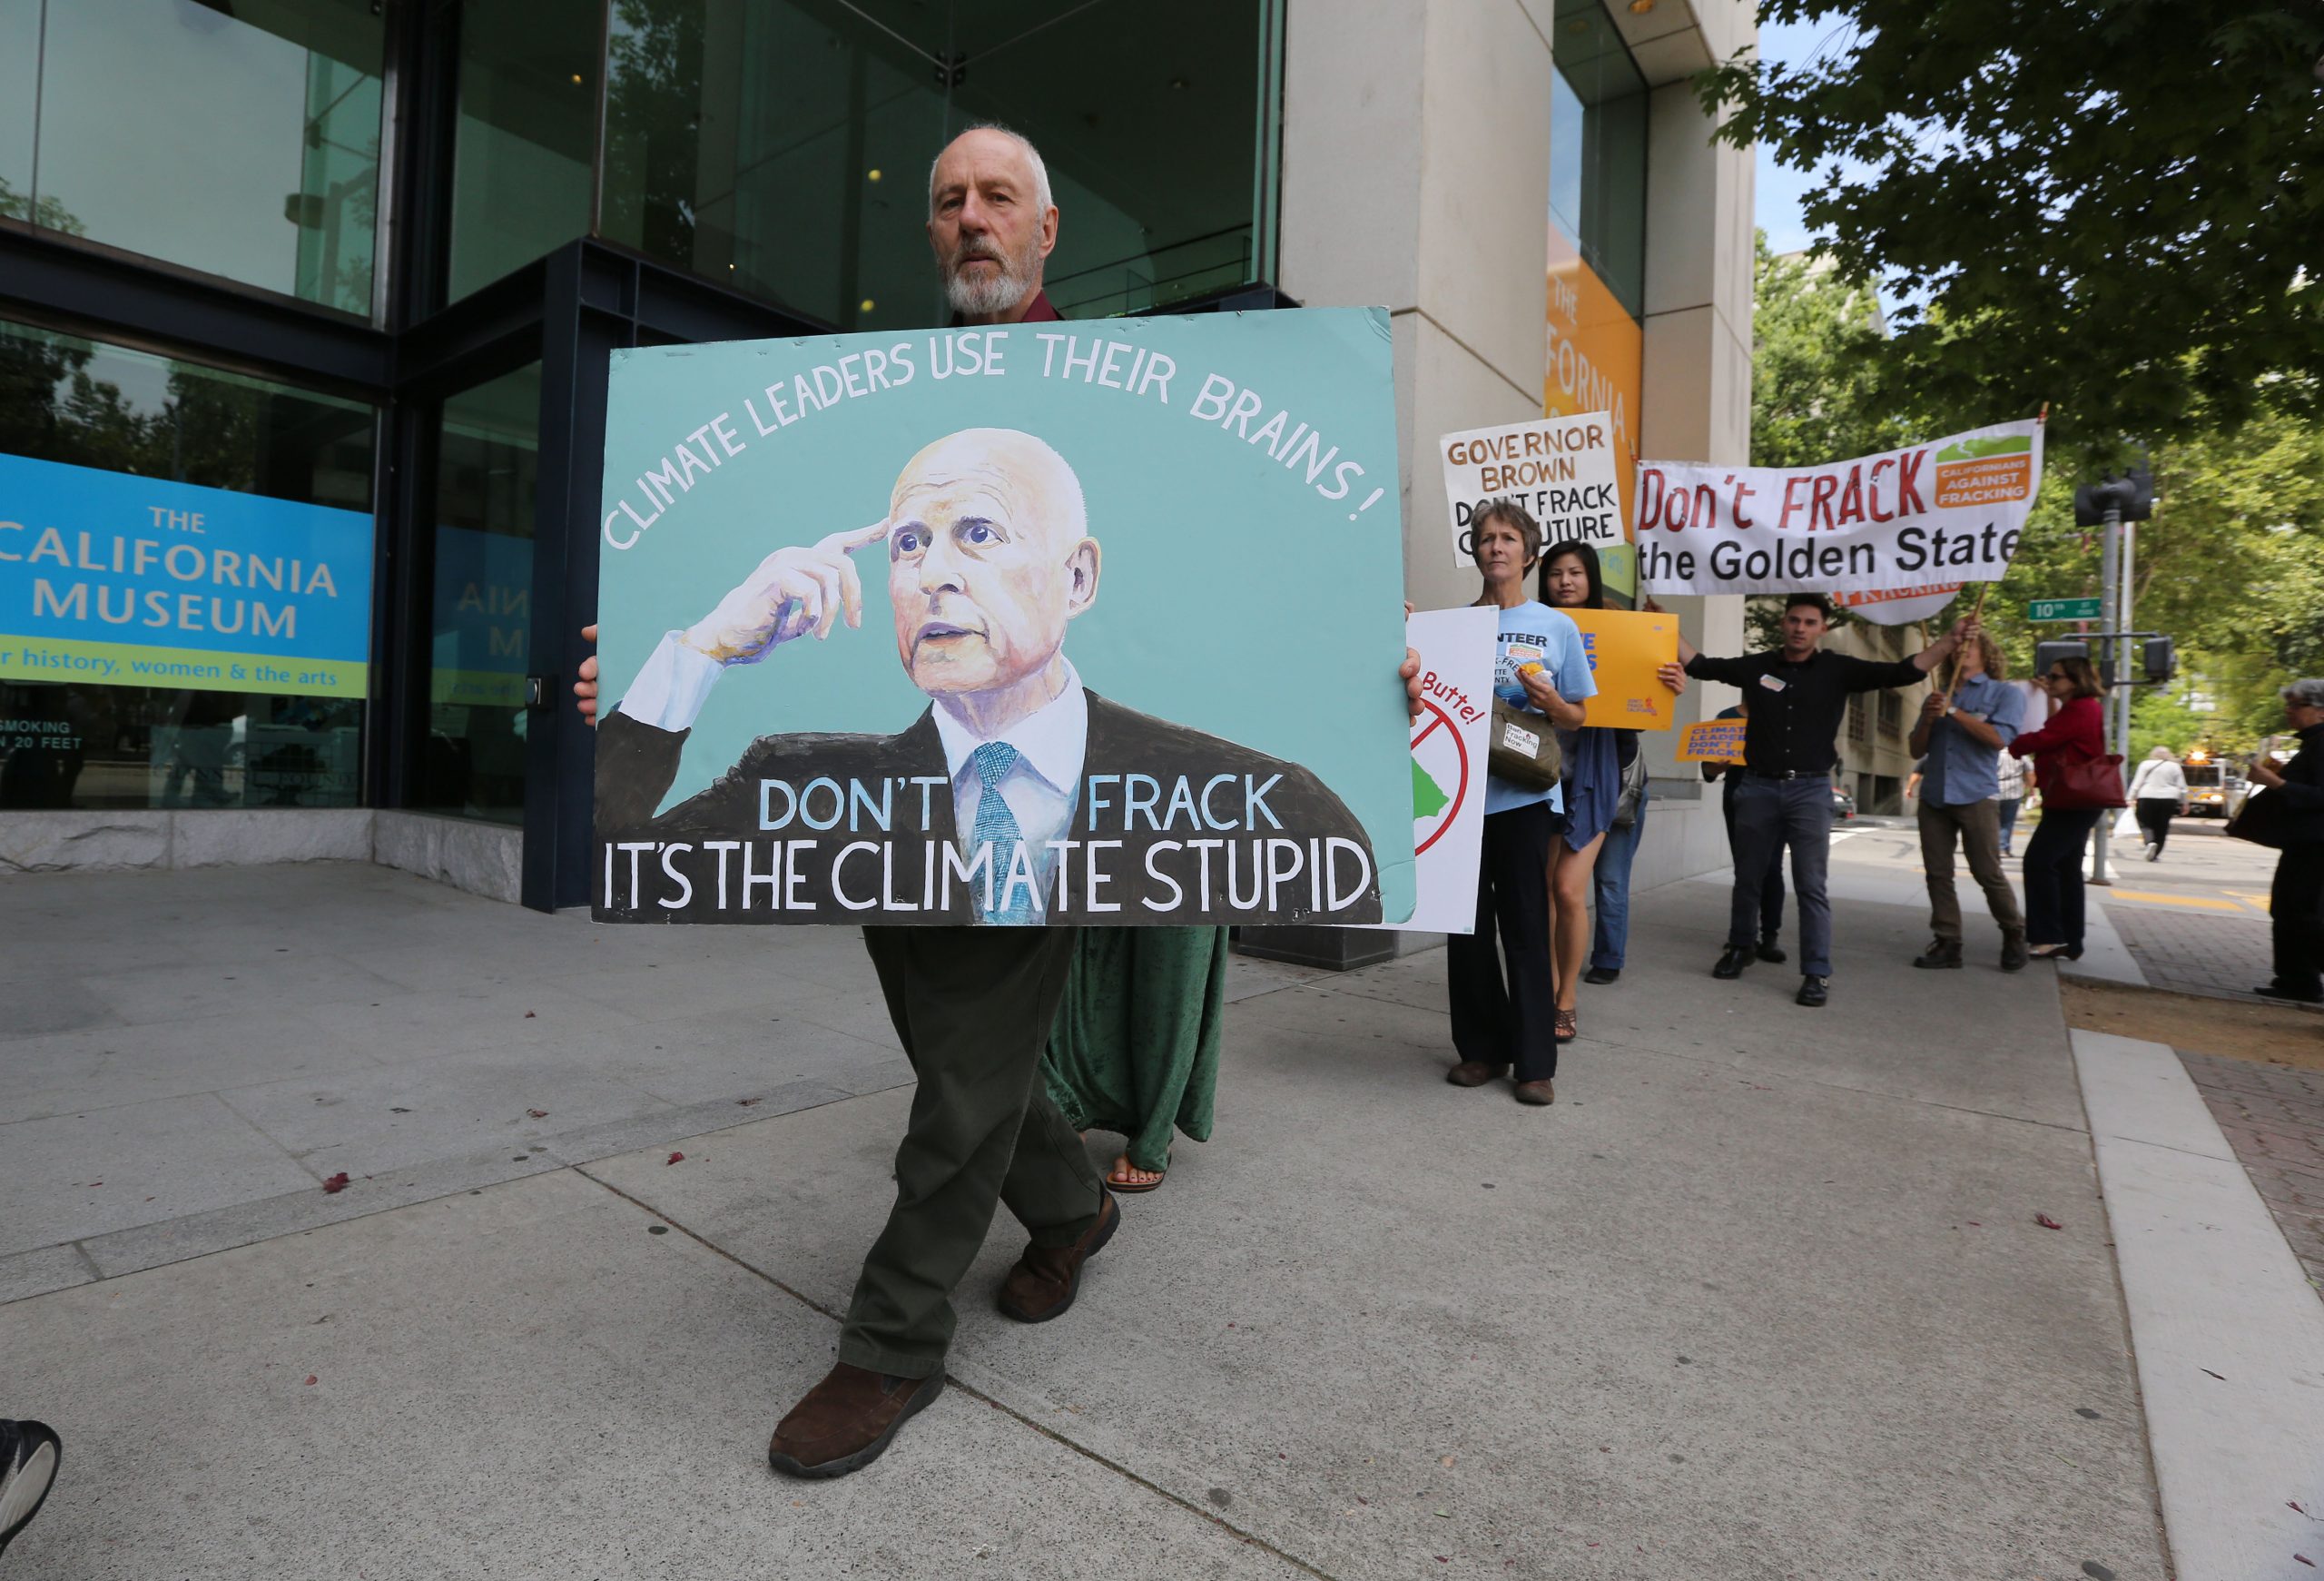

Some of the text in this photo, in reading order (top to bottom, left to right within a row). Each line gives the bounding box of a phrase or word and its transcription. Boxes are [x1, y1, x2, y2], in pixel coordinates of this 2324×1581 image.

[1554, 275, 1578, 325] THE
[604, 331, 1384, 550] CLIMATE LEADERS USE THEIR BRAINS!
[1447, 424, 1605, 466] GOVERNOR
[1482, 456, 1576, 492] BROWN
[1639, 450, 1928, 532] Don't FRACK
[1939, 486, 2024, 505] FRACKING
[1945, 472, 2020, 490] AGAINST
[147, 506, 205, 534] THE
[1455, 482, 1617, 528] D'T FRACK
[0, 520, 338, 598] CALIFORNIA
[1638, 541, 1696, 580] the
[1710, 537, 1875, 580] Golden
[1896, 521, 2021, 571] State
[33, 578, 296, 639] MUSEUM
[23, 648, 122, 677] history,
[132, 660, 220, 679] women
[230, 664, 247, 680] &
[255, 666, 290, 683] the
[299, 672, 337, 687] arts
[1423, 671, 1485, 725] Butte!
[15, 736, 34, 748] 20
[41, 737, 83, 749] FEET
[1504, 736, 1522, 747] Now
[1506, 724, 1522, 735] Ban
[1506, 729, 1539, 748] Fracking
[759, 774, 1284, 832] DON'T FRACK
[604, 837, 1372, 913] IT'S THE CLIMATE STUPID
